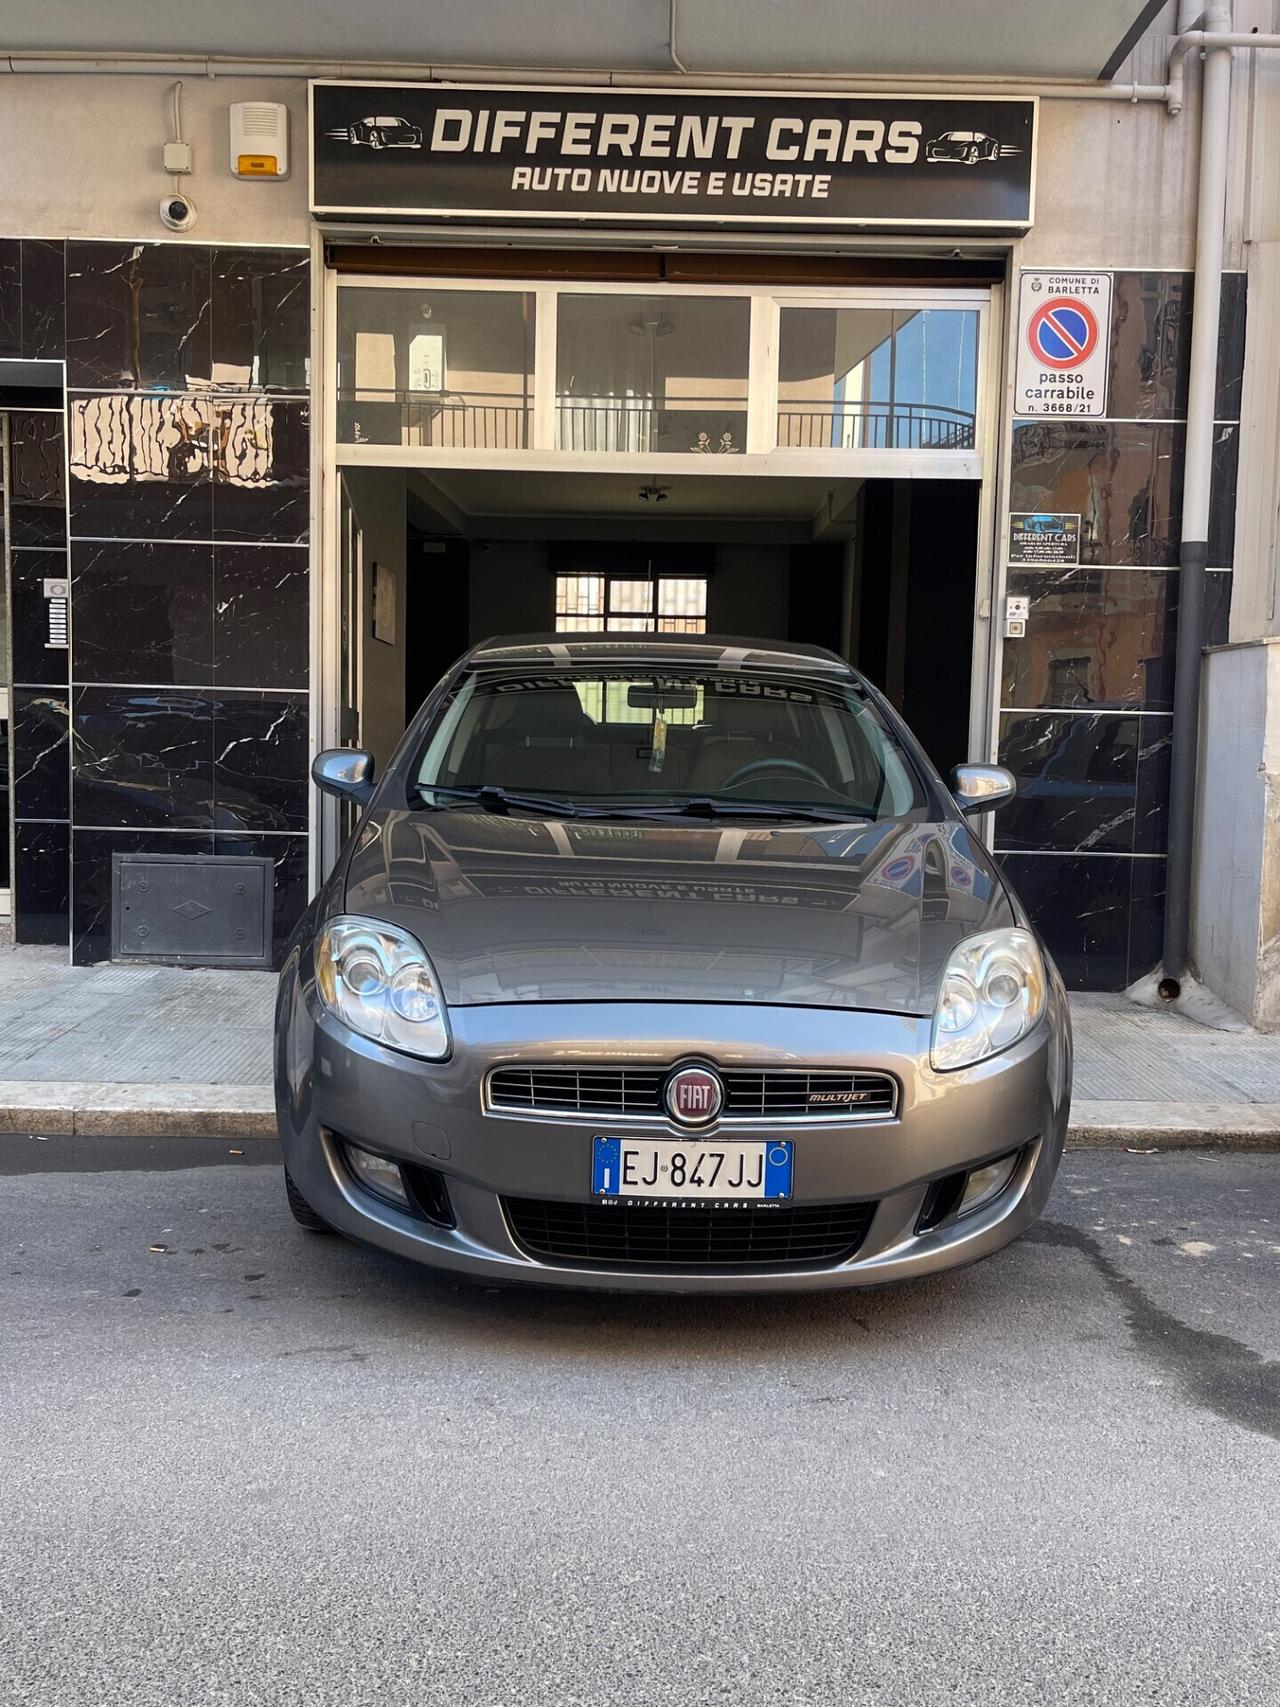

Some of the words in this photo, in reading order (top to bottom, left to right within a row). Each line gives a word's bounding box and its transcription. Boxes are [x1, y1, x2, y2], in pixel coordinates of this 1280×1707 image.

[430, 108, 755, 159] DIFFERENT
[765, 118, 922, 164] CARS
[511, 167, 592, 192] AUTO
[597, 169, 701, 195] NUOVE
[706, 172, 727, 195] E
[732, 173, 832, 198] USATE
[1049, 277, 1087, 285] COMUNE
[1048, 286, 1100, 295] BARLETTA
[1039, 373, 1084, 384] passo
[1025, 386, 1095, 400] carrabile
[1028, 404, 1038, 412] n.
[1043, 403, 1091, 413] 3668/21
[680, 1084, 711, 1110] FIAT
[808, 1092, 868, 1103] MULTIJET
